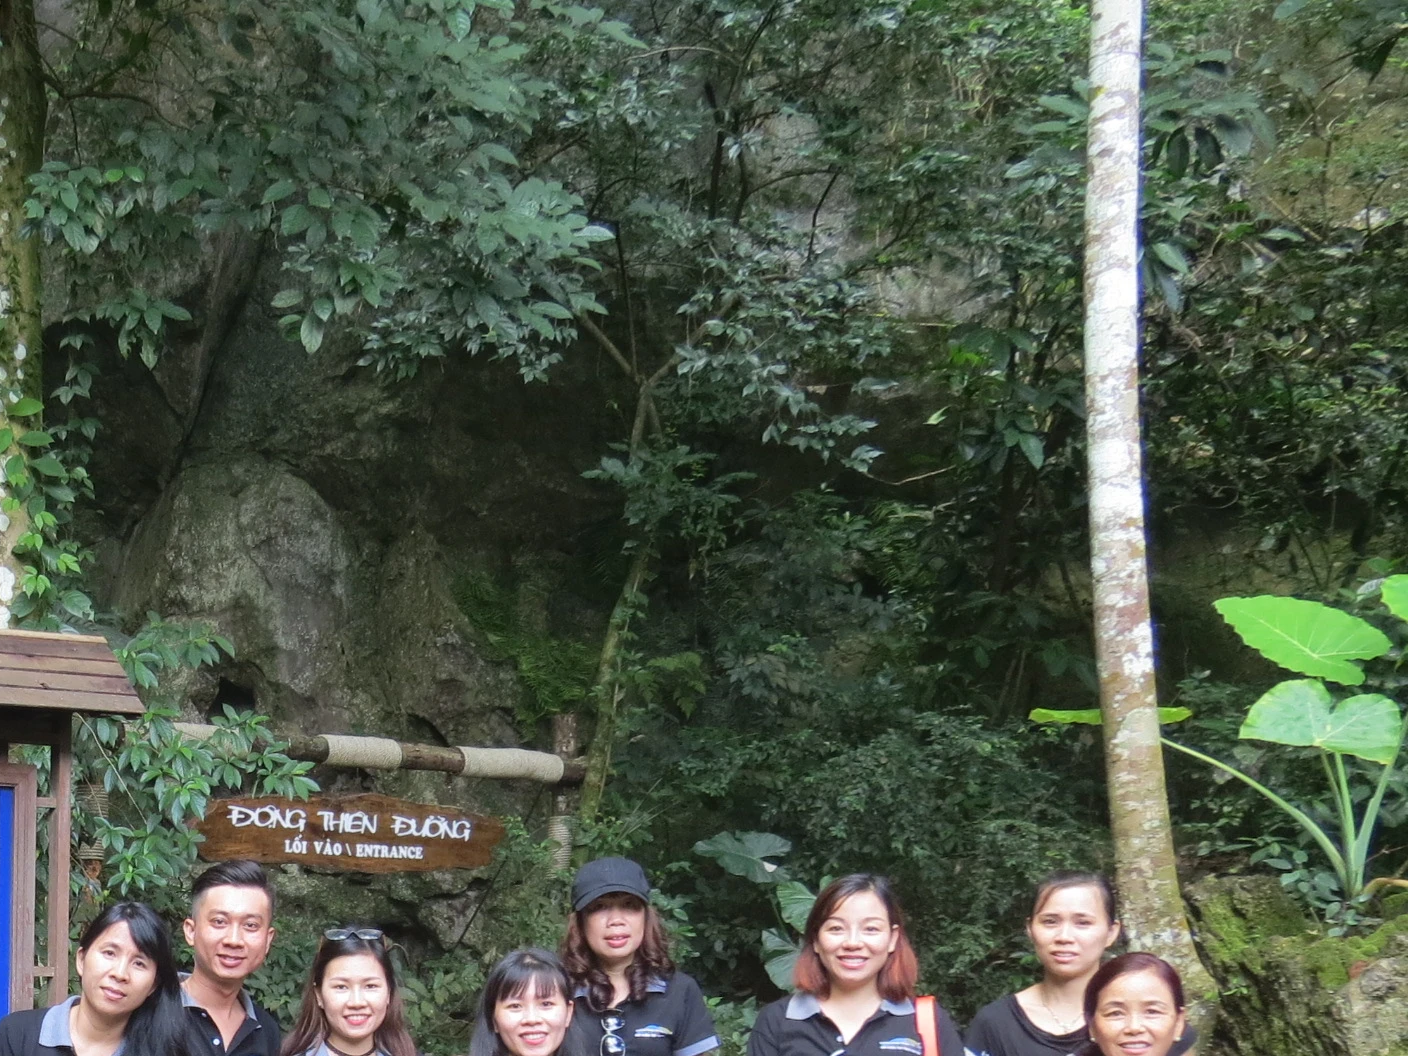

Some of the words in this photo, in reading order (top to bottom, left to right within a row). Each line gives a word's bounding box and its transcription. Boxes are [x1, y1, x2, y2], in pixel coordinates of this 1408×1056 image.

[317, 811, 378, 834] THIÊN
[284, 834, 308, 854] LỐI
[314, 838, 342, 856] VÀO
[356, 844, 424, 860] ENTRANCE
